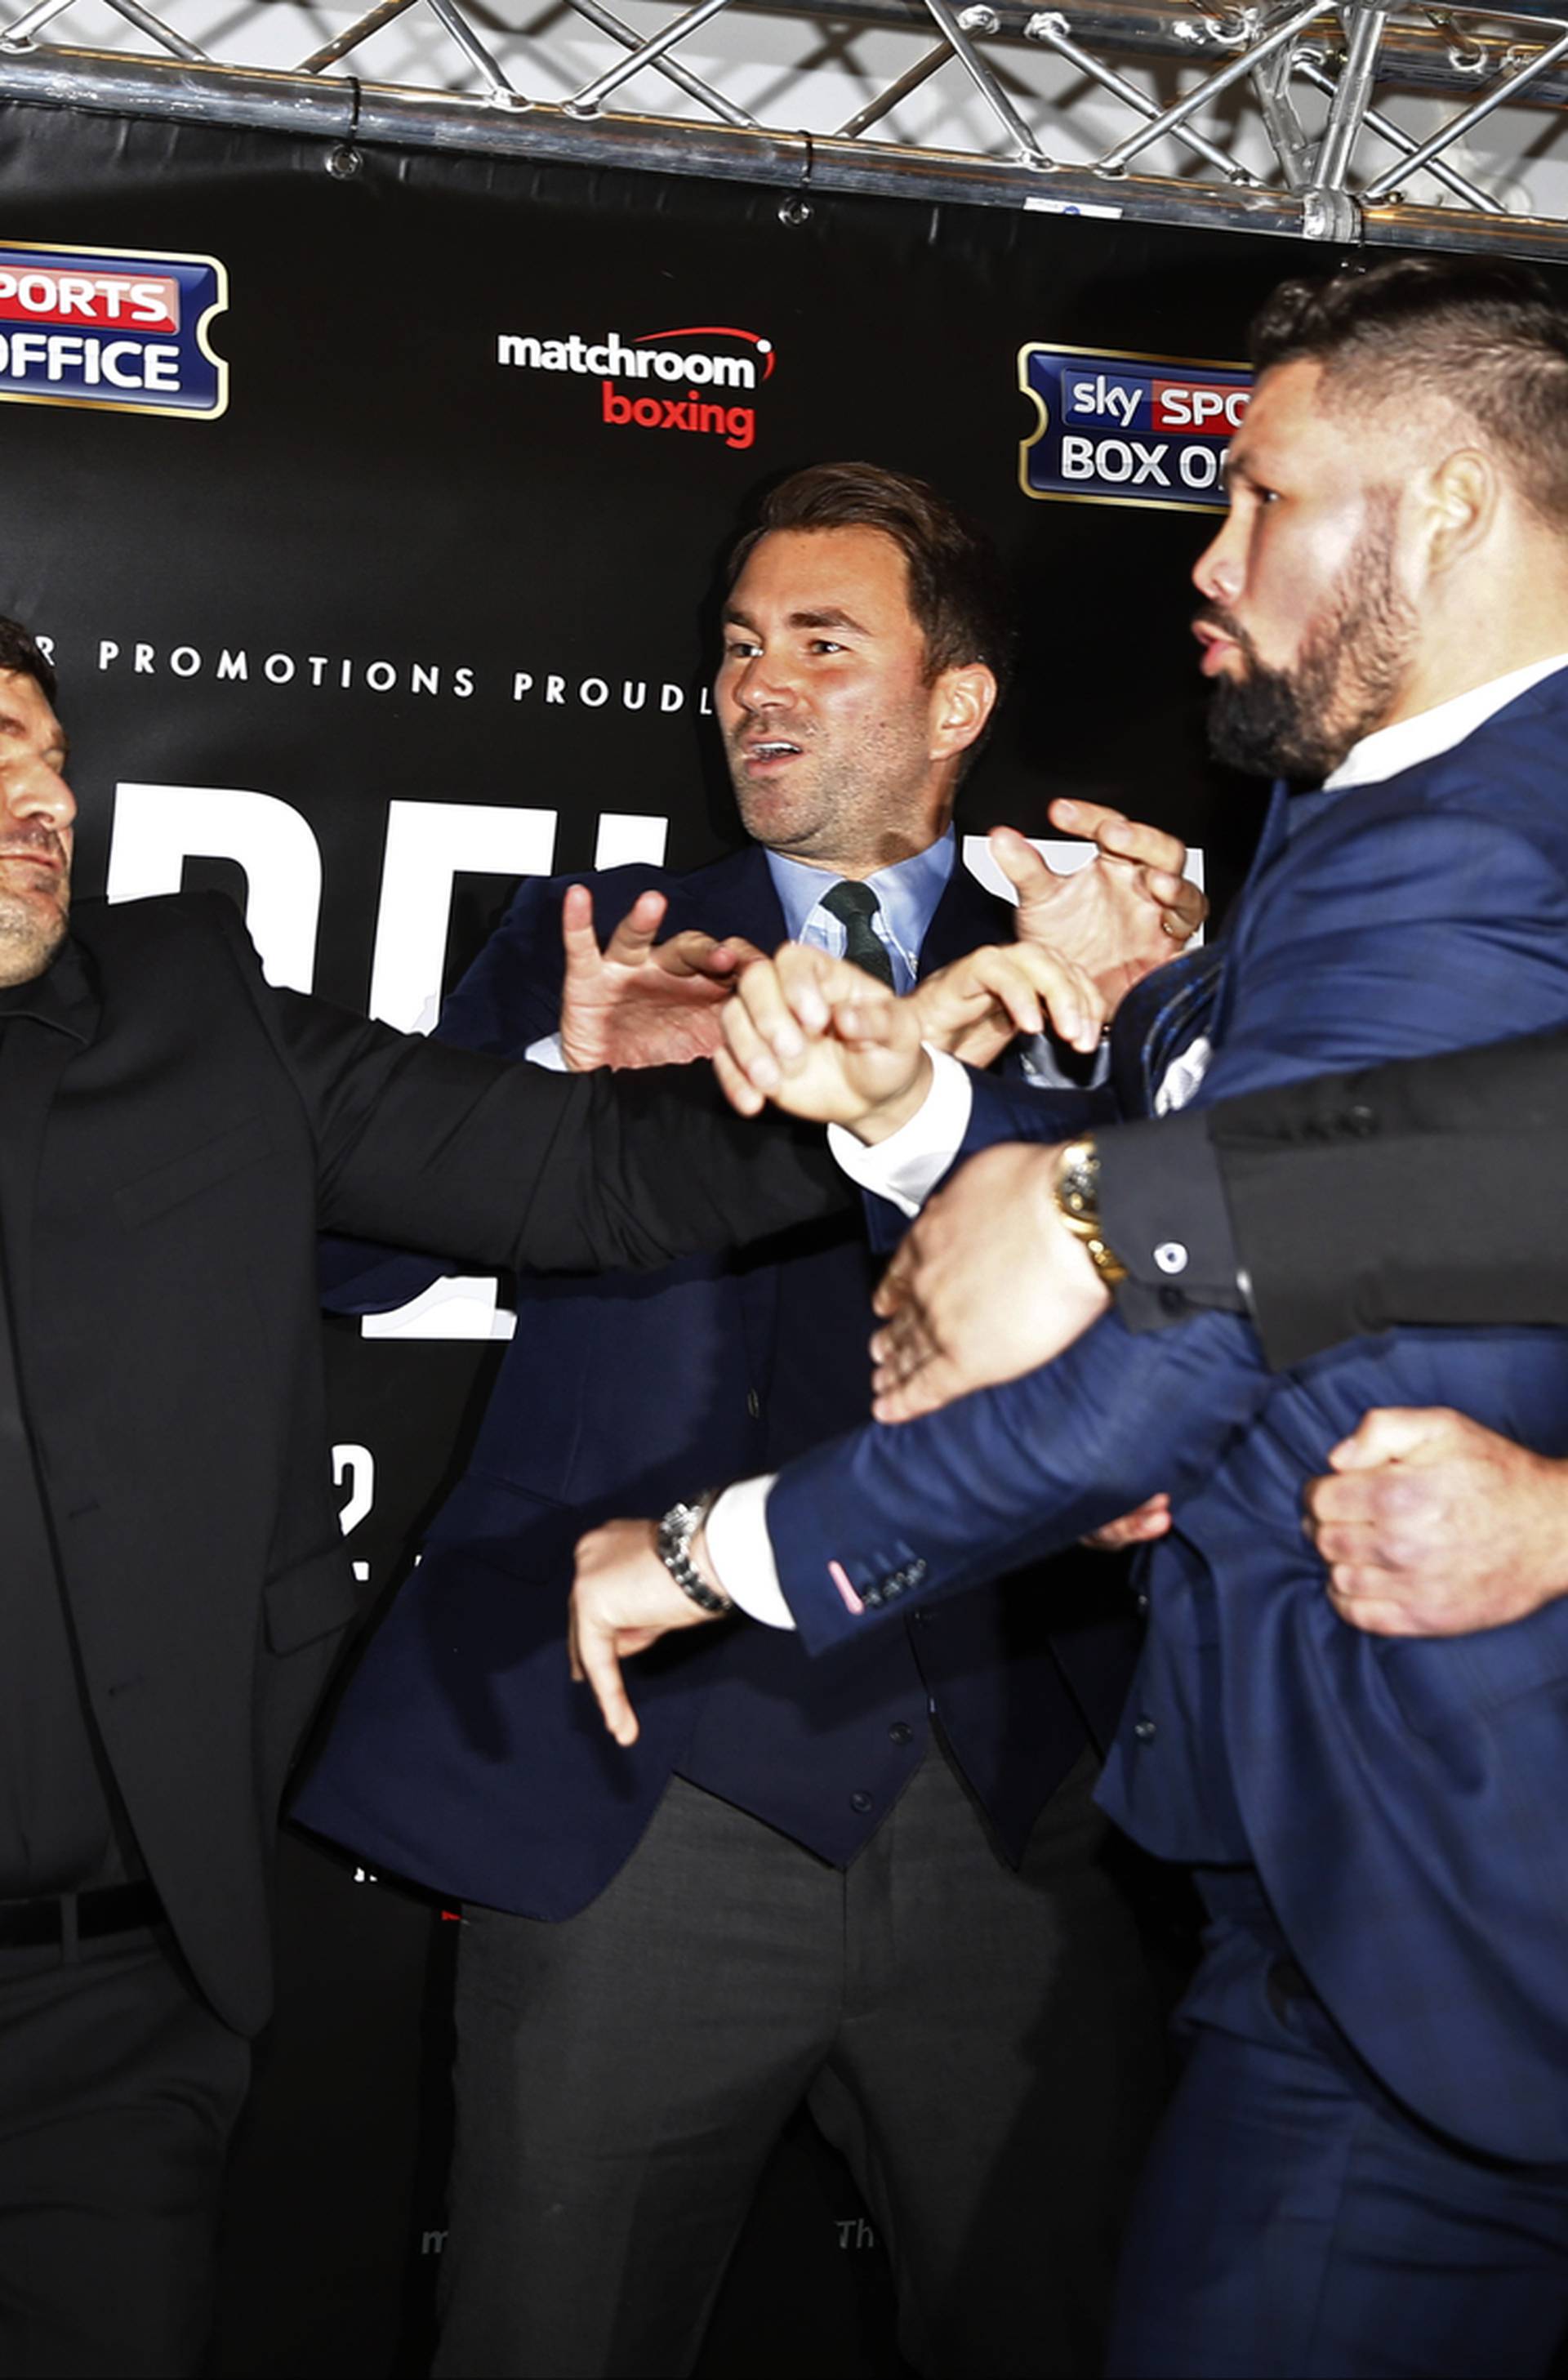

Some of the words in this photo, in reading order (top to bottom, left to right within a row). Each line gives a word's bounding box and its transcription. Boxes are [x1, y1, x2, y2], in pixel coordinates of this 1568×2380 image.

[0, 332, 180, 392] FFICE
[497, 332, 755, 389] matchroom
[603, 380, 755, 450] boxing
[1072, 375, 1143, 427] sky
[1061, 435, 1171, 487] BOX
[98, 640, 474, 698] PROMOTIONS
